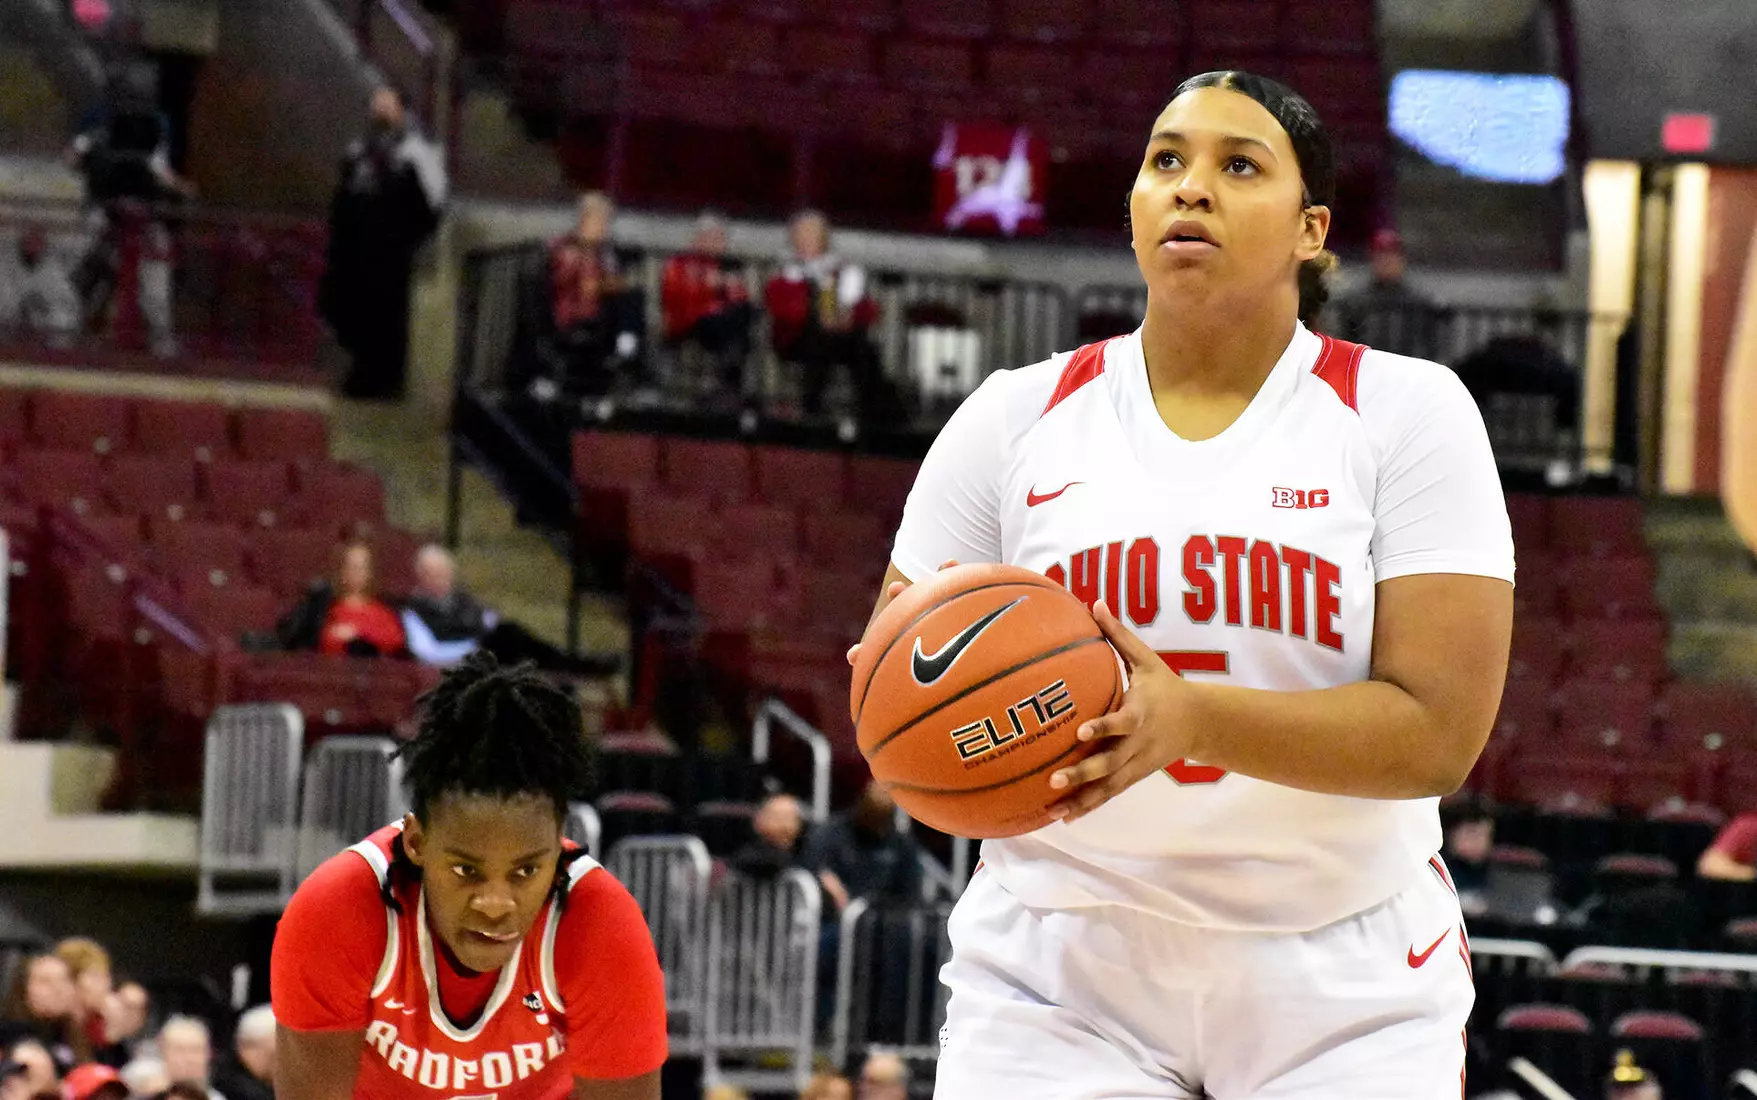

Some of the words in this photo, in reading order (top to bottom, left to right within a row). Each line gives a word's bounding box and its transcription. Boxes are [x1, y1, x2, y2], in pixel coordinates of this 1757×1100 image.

[1181, 533, 1345, 652] STATE
[950, 679, 1075, 761] ELITE
[964, 711, 1078, 770] CHAMPIONSHIP
